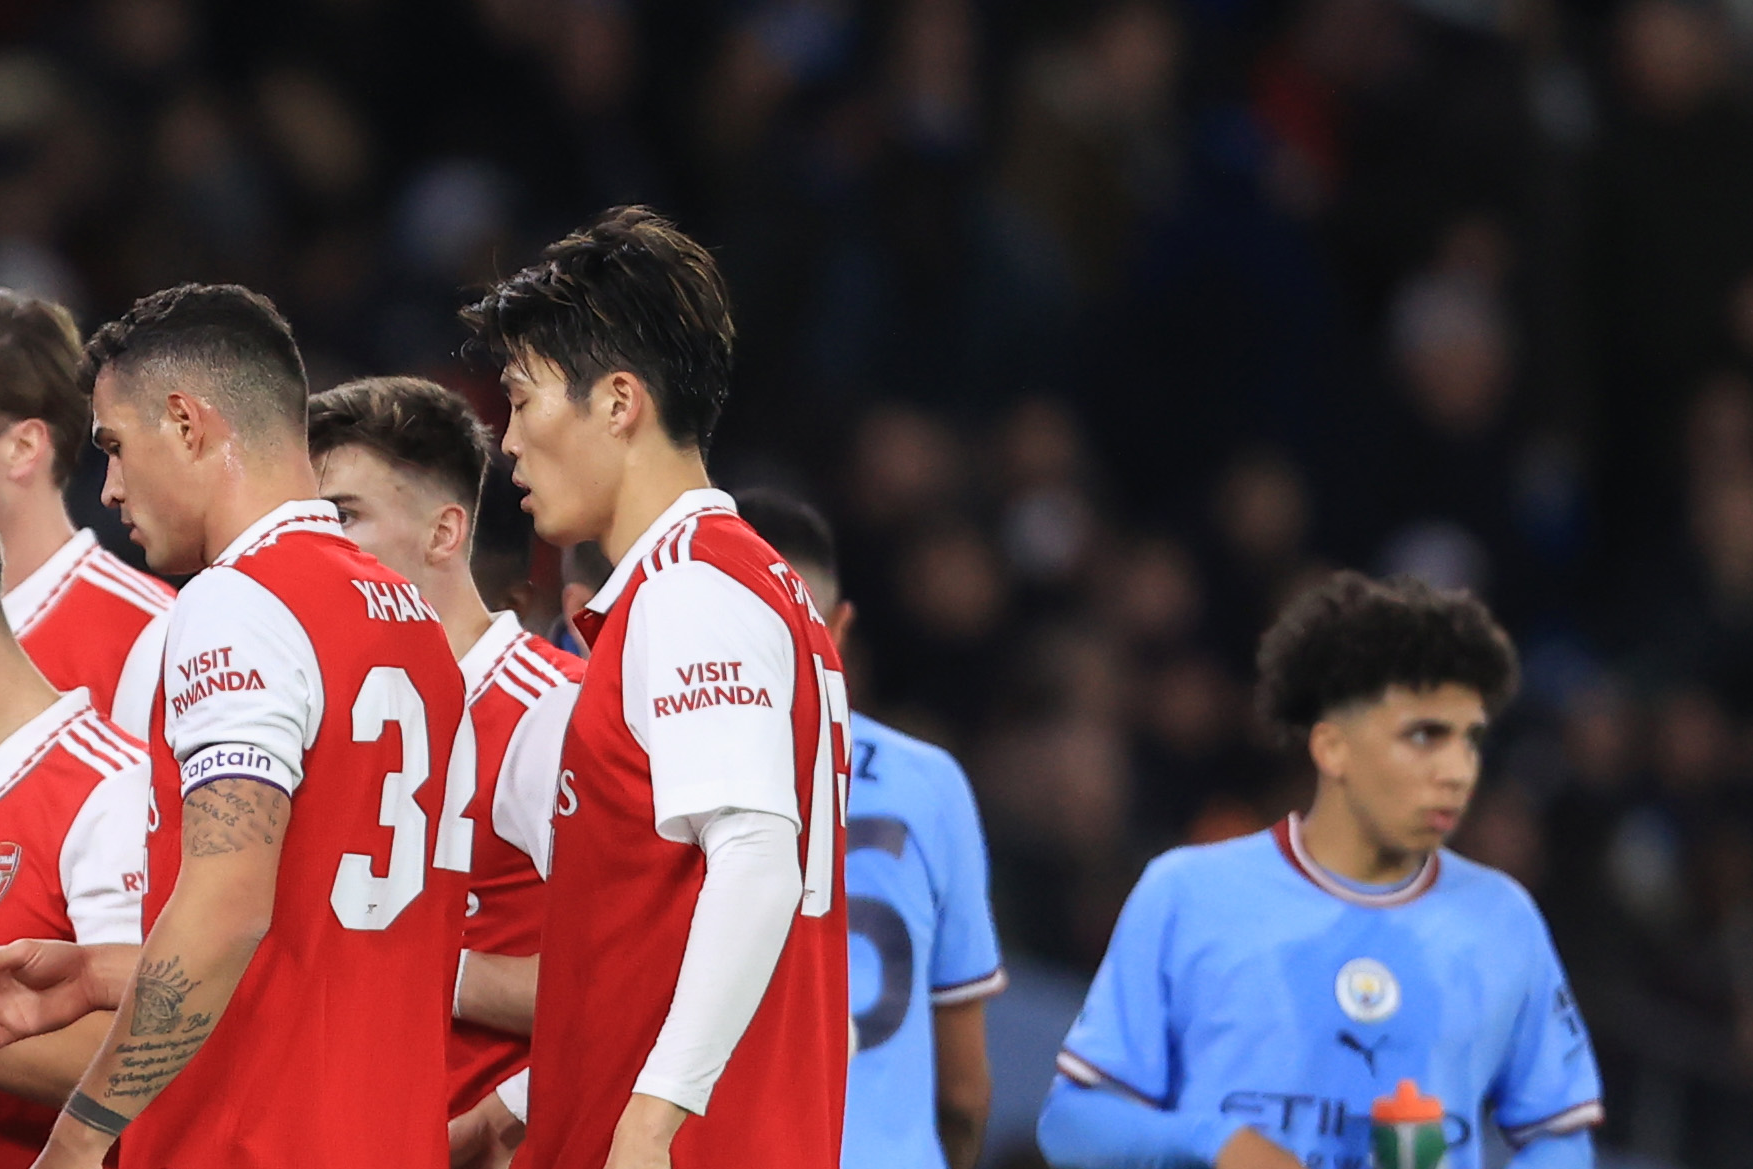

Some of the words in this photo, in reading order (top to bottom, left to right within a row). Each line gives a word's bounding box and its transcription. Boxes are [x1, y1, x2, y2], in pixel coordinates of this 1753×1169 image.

[350, 579, 441, 622] XHAK
[177, 646, 232, 682] VISIT
[675, 661, 742, 686] VISIT
[171, 668, 266, 718] RWANDA
[653, 686, 773, 718] RWANDA
